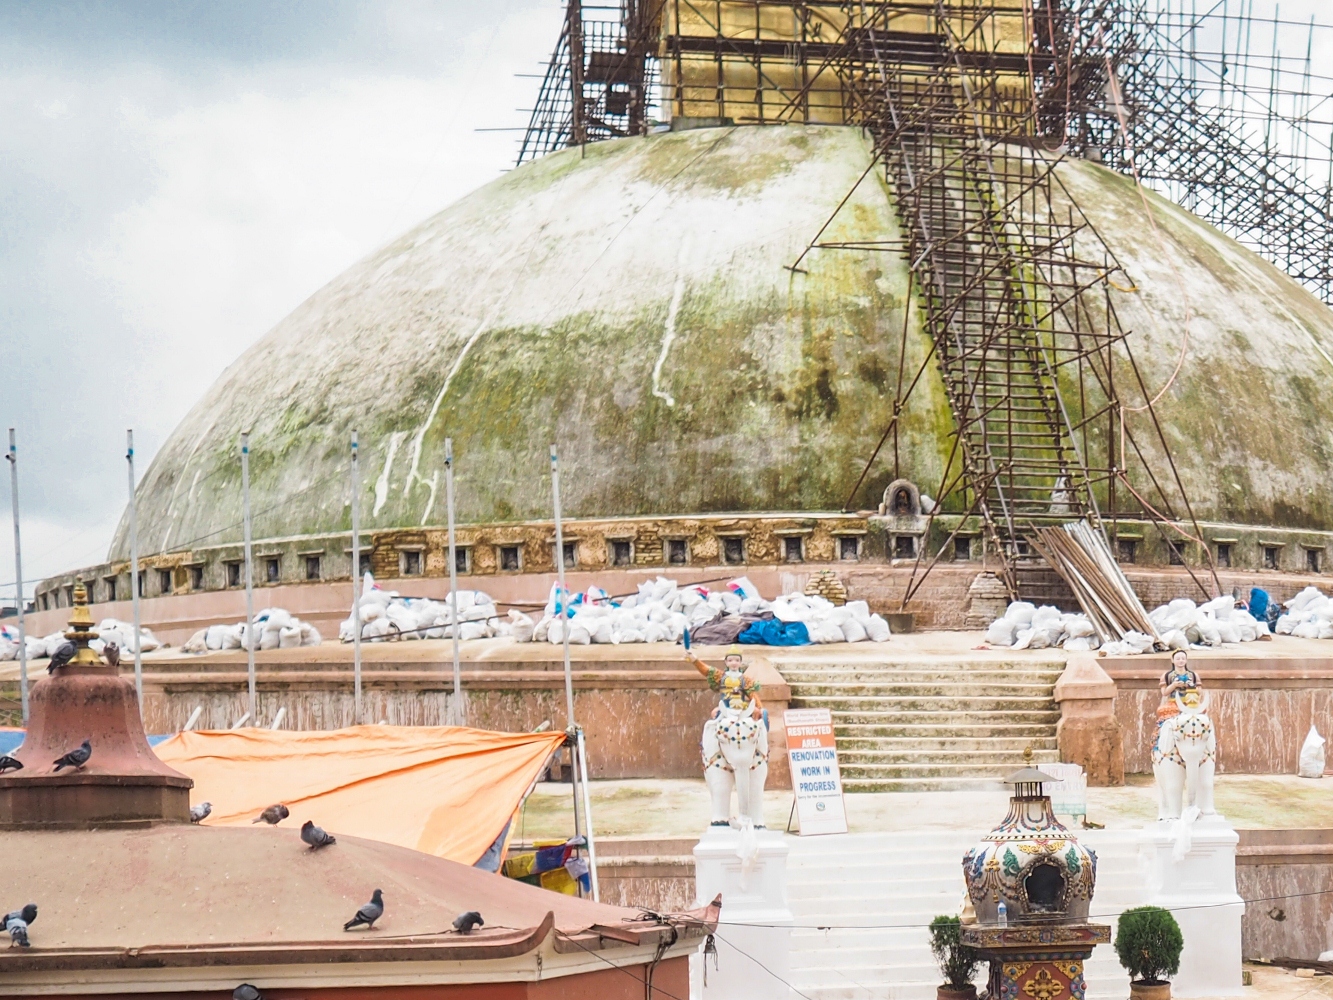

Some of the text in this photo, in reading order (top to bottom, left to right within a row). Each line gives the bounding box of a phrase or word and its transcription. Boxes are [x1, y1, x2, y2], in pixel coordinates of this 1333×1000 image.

[787, 726, 831, 736] RESTRICTED
[802, 738, 821, 748] AREA
[792, 751, 835, 761] RENOVATION
[800, 766, 830, 776] WORK IN
[800, 781, 836, 792] PROGRESS
